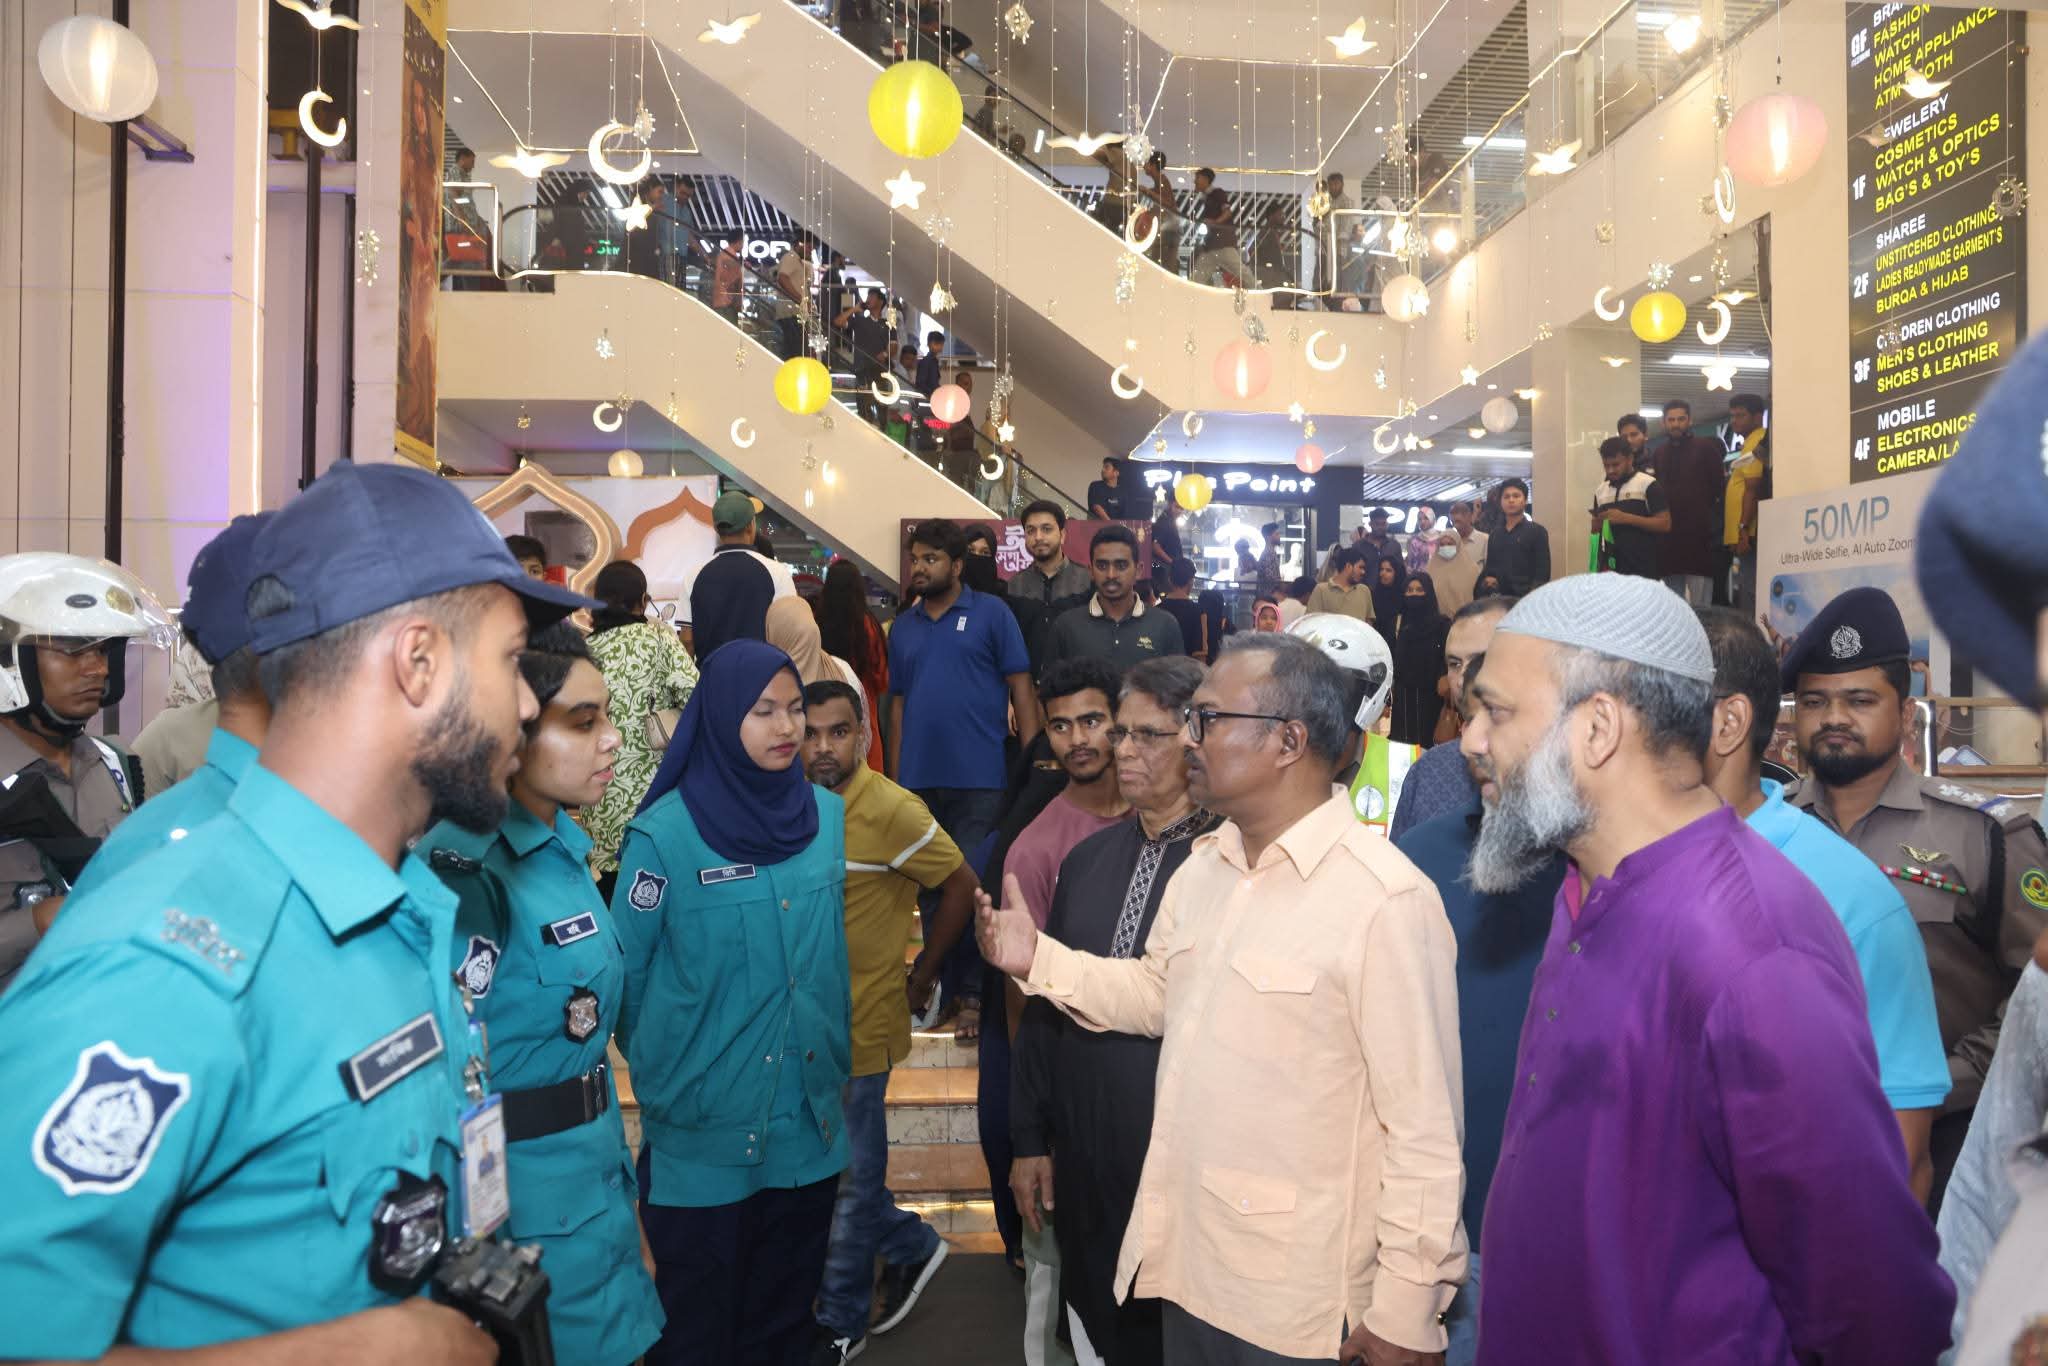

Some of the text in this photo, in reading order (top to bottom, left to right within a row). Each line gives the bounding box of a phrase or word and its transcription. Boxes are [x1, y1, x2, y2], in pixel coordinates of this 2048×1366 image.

[1873, 3, 1904, 27] BRA
[1873, 3, 1930, 48] FASHION
[1874, 27, 1920, 67] WATCH
[1874, 54, 1912, 90] HOME
[1875, 82, 1901, 110] ATM
[1875, 113, 1957, 170] COSMETICS
[1876, 113, 2000, 191] WATCH & OPTICS
[1852, 174, 1866, 200] 1F
[1876, 147, 1981, 213] BAG'S & TOY'S
[1876, 213, 1926, 249] SHAREE
[1876, 226, 2003, 293] LADIES READYMADE GARMENT'S
[1853, 272, 1869, 298] 2F
[1876, 265, 1969, 314] BURQA & HIJAB
[1876, 291, 2001, 350] CDREN CLOTHING
[1876, 320, 1988, 372] MEN'S CLOTHING
[1854, 358, 1871, 383] 3F
[1877, 341, 1999, 393] SHOES & LEATHER
[1877, 398, 1936, 431] MOBILE
[1877, 413, 1977, 452] ELECTRONICS
[1854, 437, 1871, 461] 4F
[1223, 472, 1316, 493] Point
[1803, 496, 1890, 544] 50MP
[1780, 549, 1823, 565] Ultra-Wide
[1864, 541, 1886, 554] Auto
